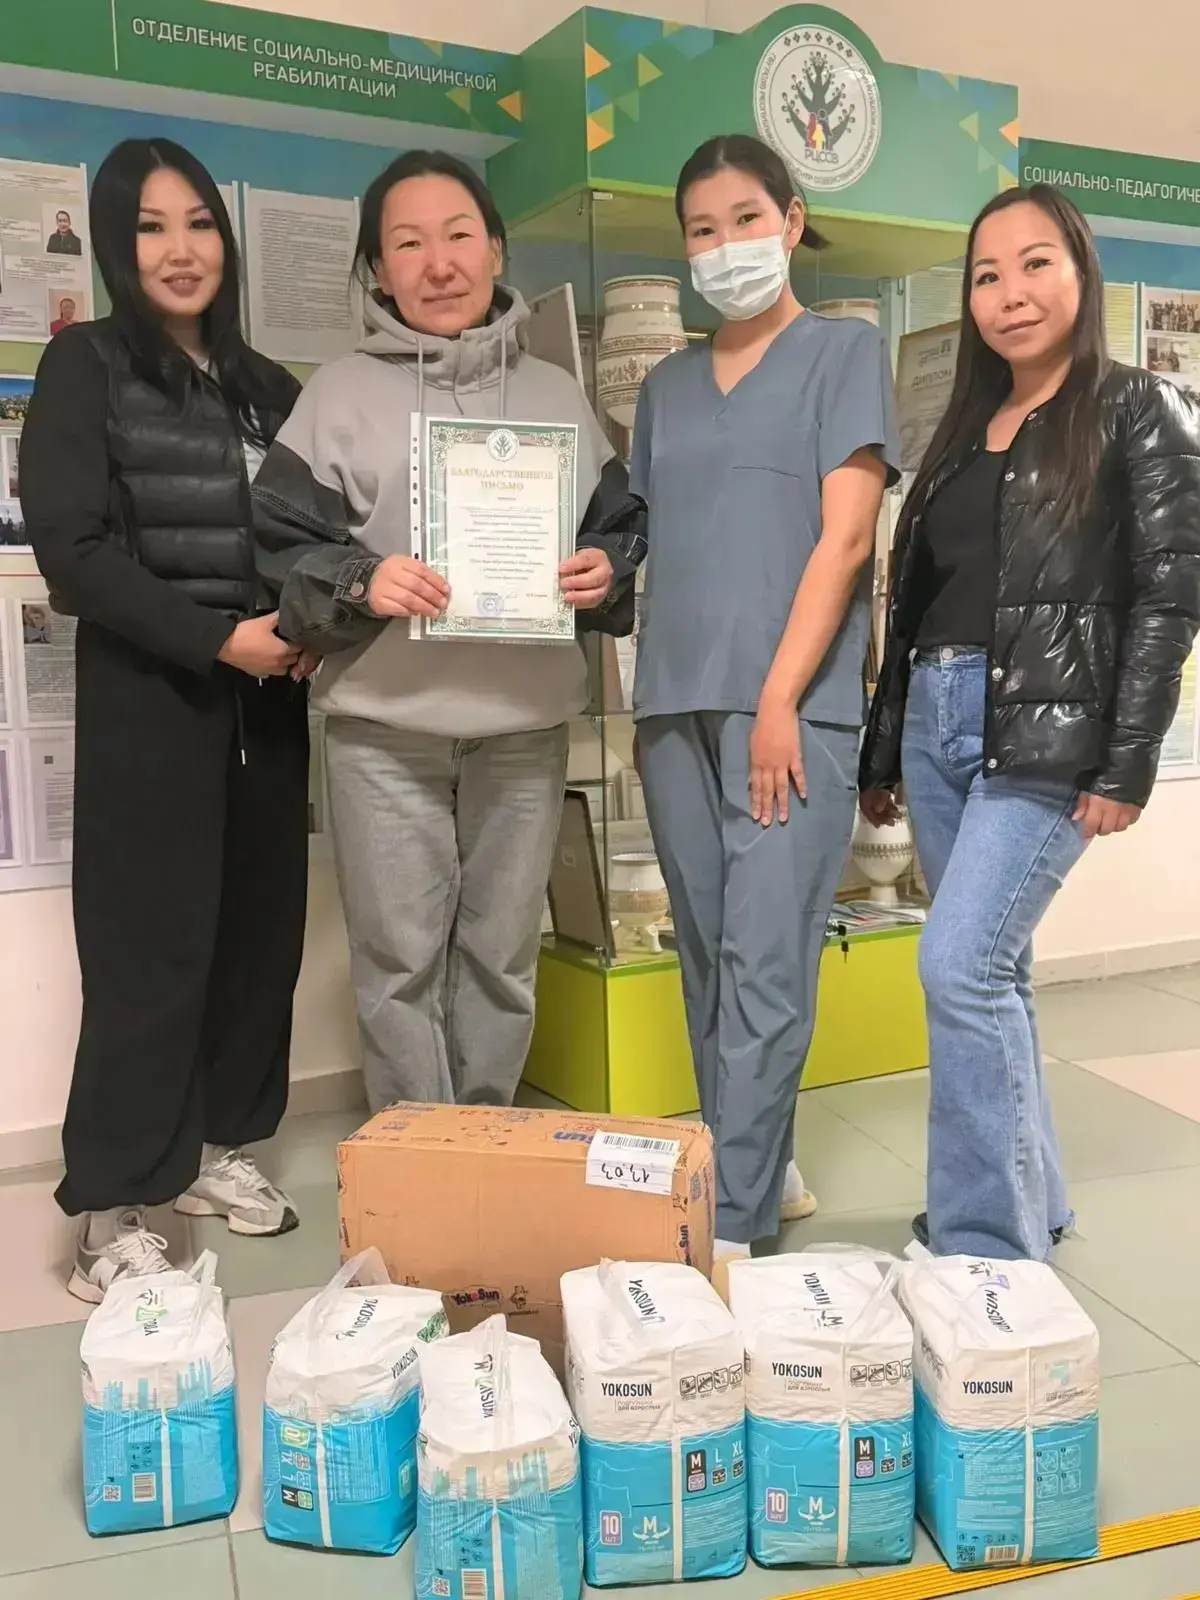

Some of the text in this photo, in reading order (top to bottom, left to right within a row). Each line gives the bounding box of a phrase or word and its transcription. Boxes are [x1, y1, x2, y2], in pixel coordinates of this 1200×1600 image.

[132, 17, 497, 92] ОТДЕЛЕНИЕ СОЦИАЛЬНО-МЕДИЦИНСКОЙ
[253, 62, 397, 98] РЕАБИЛИТАЦИИ
[480, 480, 524, 491] ПИСЬМО
[451, 1288, 500, 1306] YokoSun
[772, 1362, 822, 1378] YOKOSUN
[601, 1382, 652, 1397] YOKOSUN
[963, 1380, 1014, 1395] YOKOSUN
[715, 1447, 723, 1464] L
[859, 1439, 870, 1455] M
[691, 1453, 702, 1469] M
[283, 1489, 295, 1502] M
[768, 1491, 785, 1513] 10
[808, 1496, 823, 1515] M
[602, 1515, 619, 1535] 10
[643, 1515, 657, 1534] M
